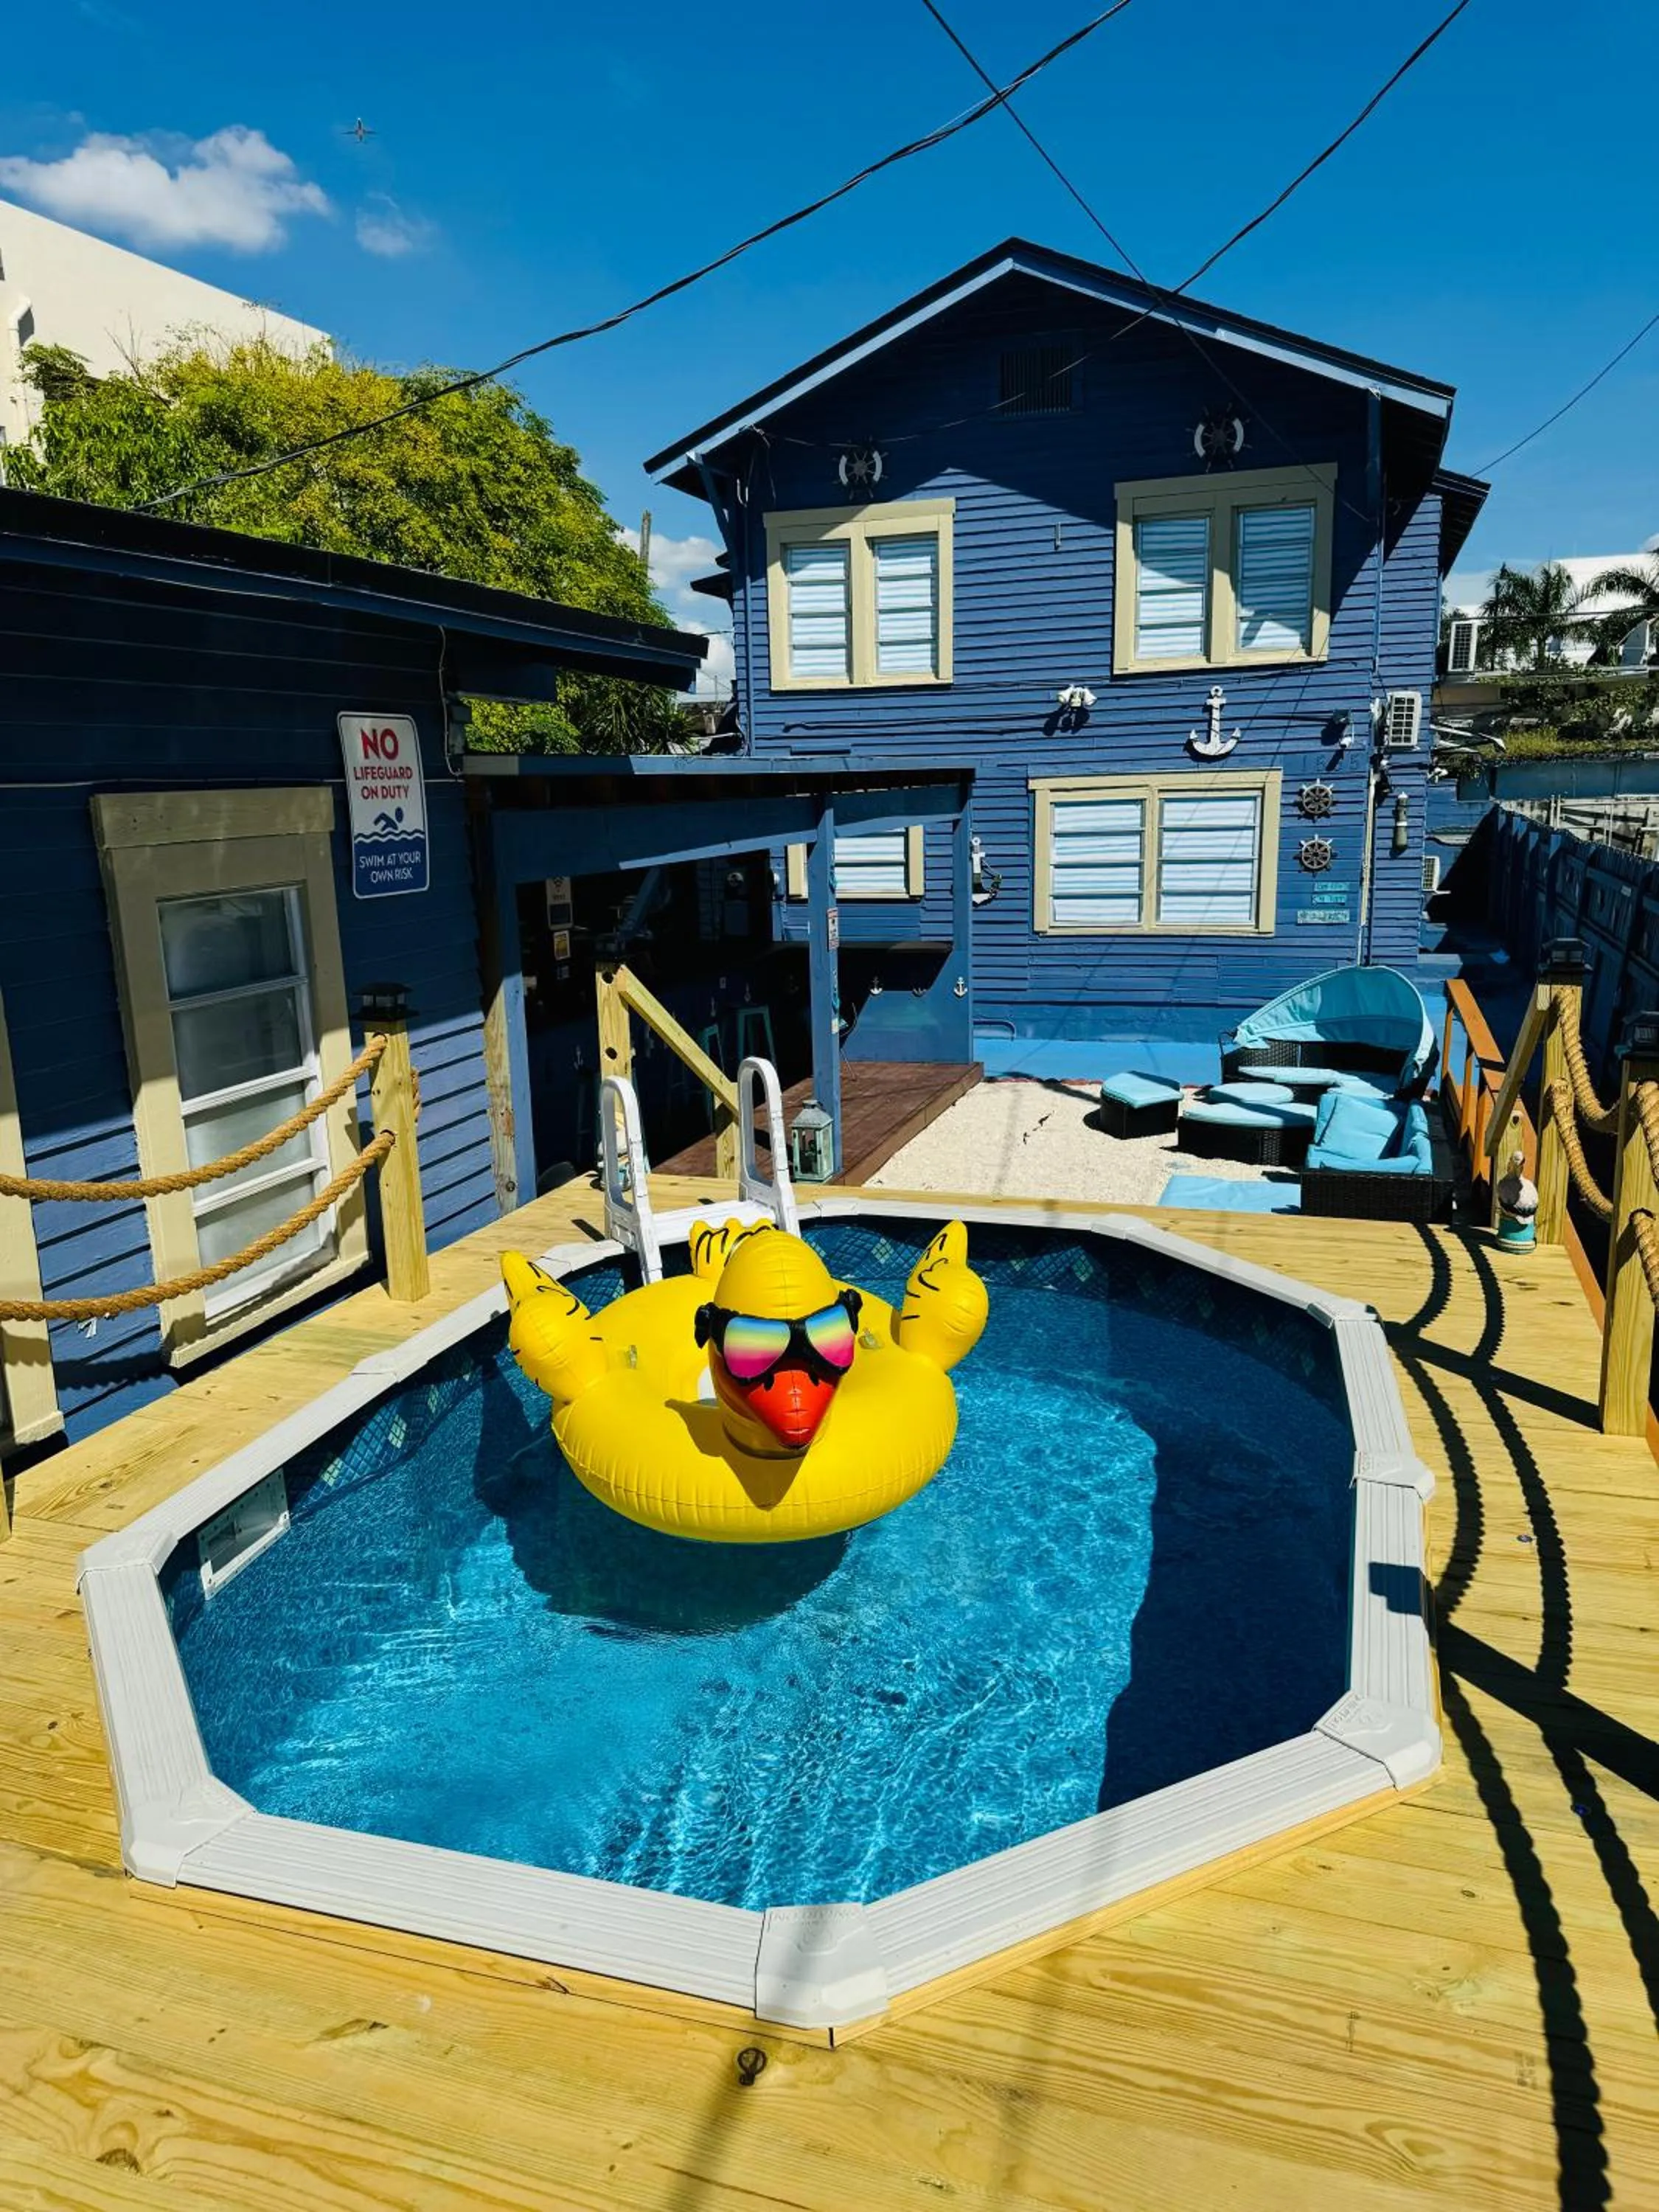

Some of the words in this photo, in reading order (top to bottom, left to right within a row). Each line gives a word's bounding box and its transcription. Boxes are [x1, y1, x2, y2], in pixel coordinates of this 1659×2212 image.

[361, 728, 399, 760] NO
[354, 766, 413, 780] LIFEGUARD
[361, 785, 378, 799] ON
[380, 785, 409, 799] DUTY
[359, 855, 384, 868] SWIM
[386, 853, 396, 866] AT
[397, 851, 421, 864] YOUR
[371, 869, 394, 883] OWN
[394, 867, 414, 880] RISK
